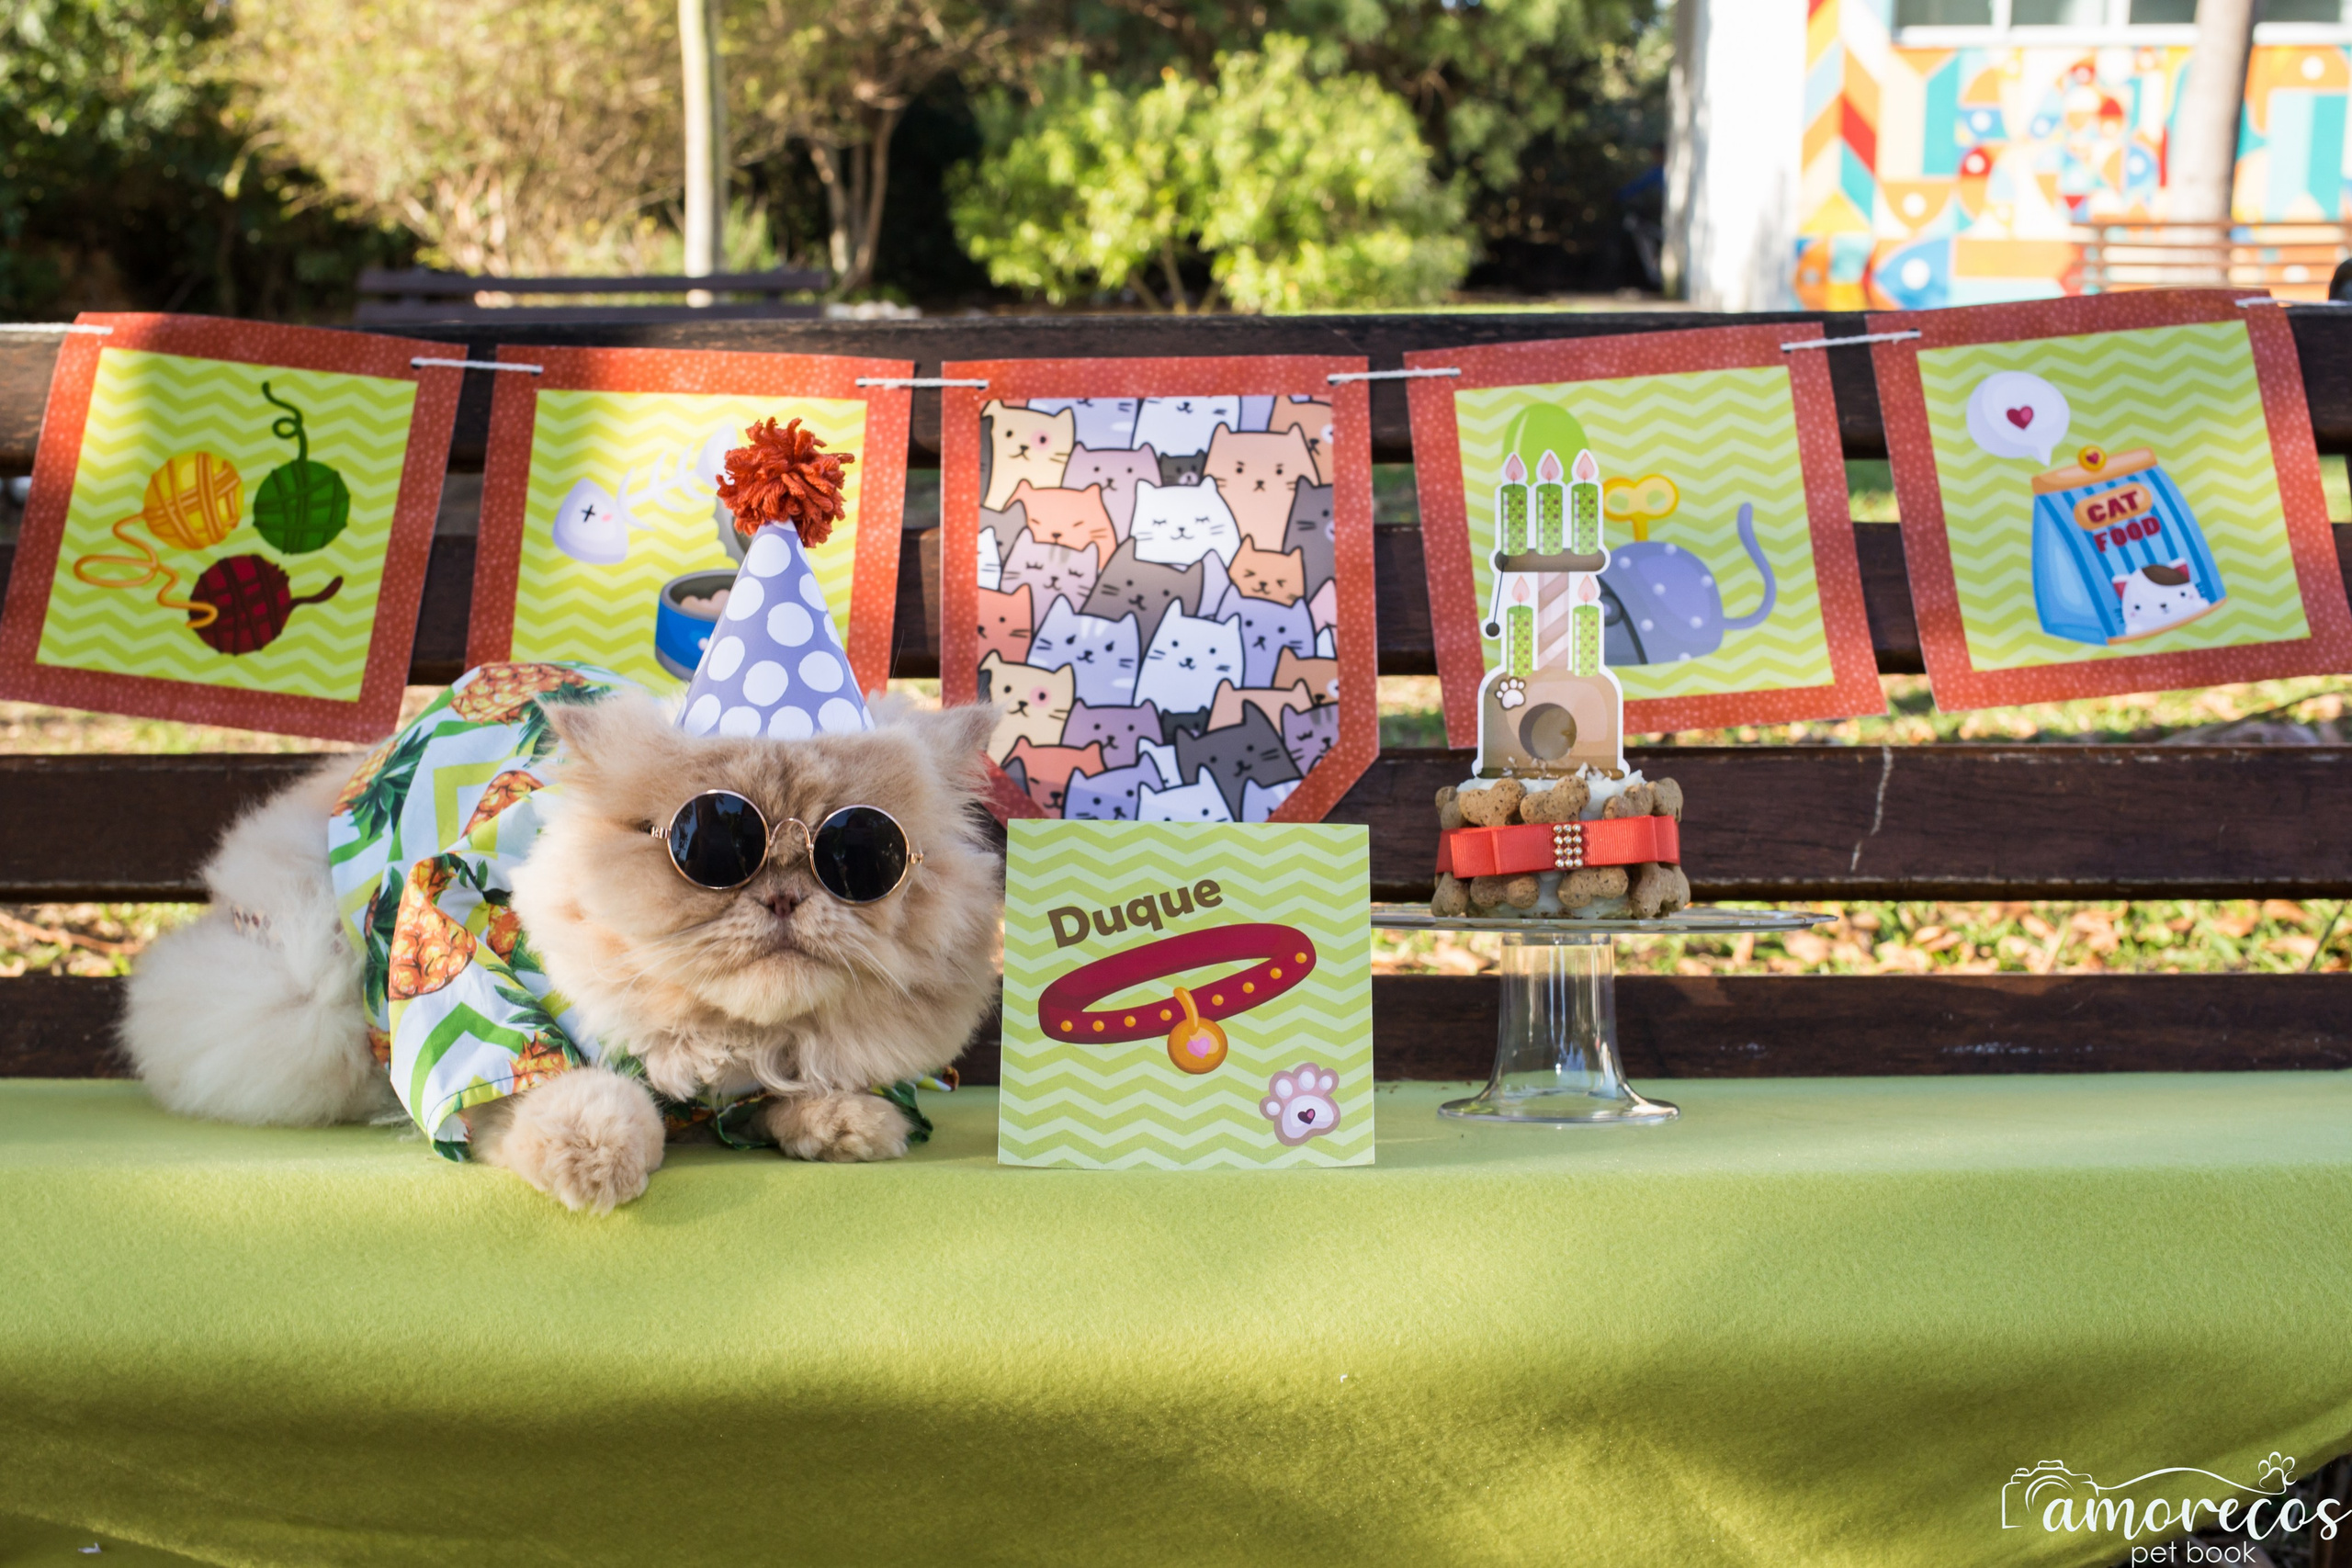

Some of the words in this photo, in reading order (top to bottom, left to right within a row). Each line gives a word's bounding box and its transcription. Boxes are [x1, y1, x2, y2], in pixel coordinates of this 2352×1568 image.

[2086, 491, 2139, 524] CAT
[2093, 516, 2161, 554] FOOD
[1047, 879, 1224, 948] Duque
